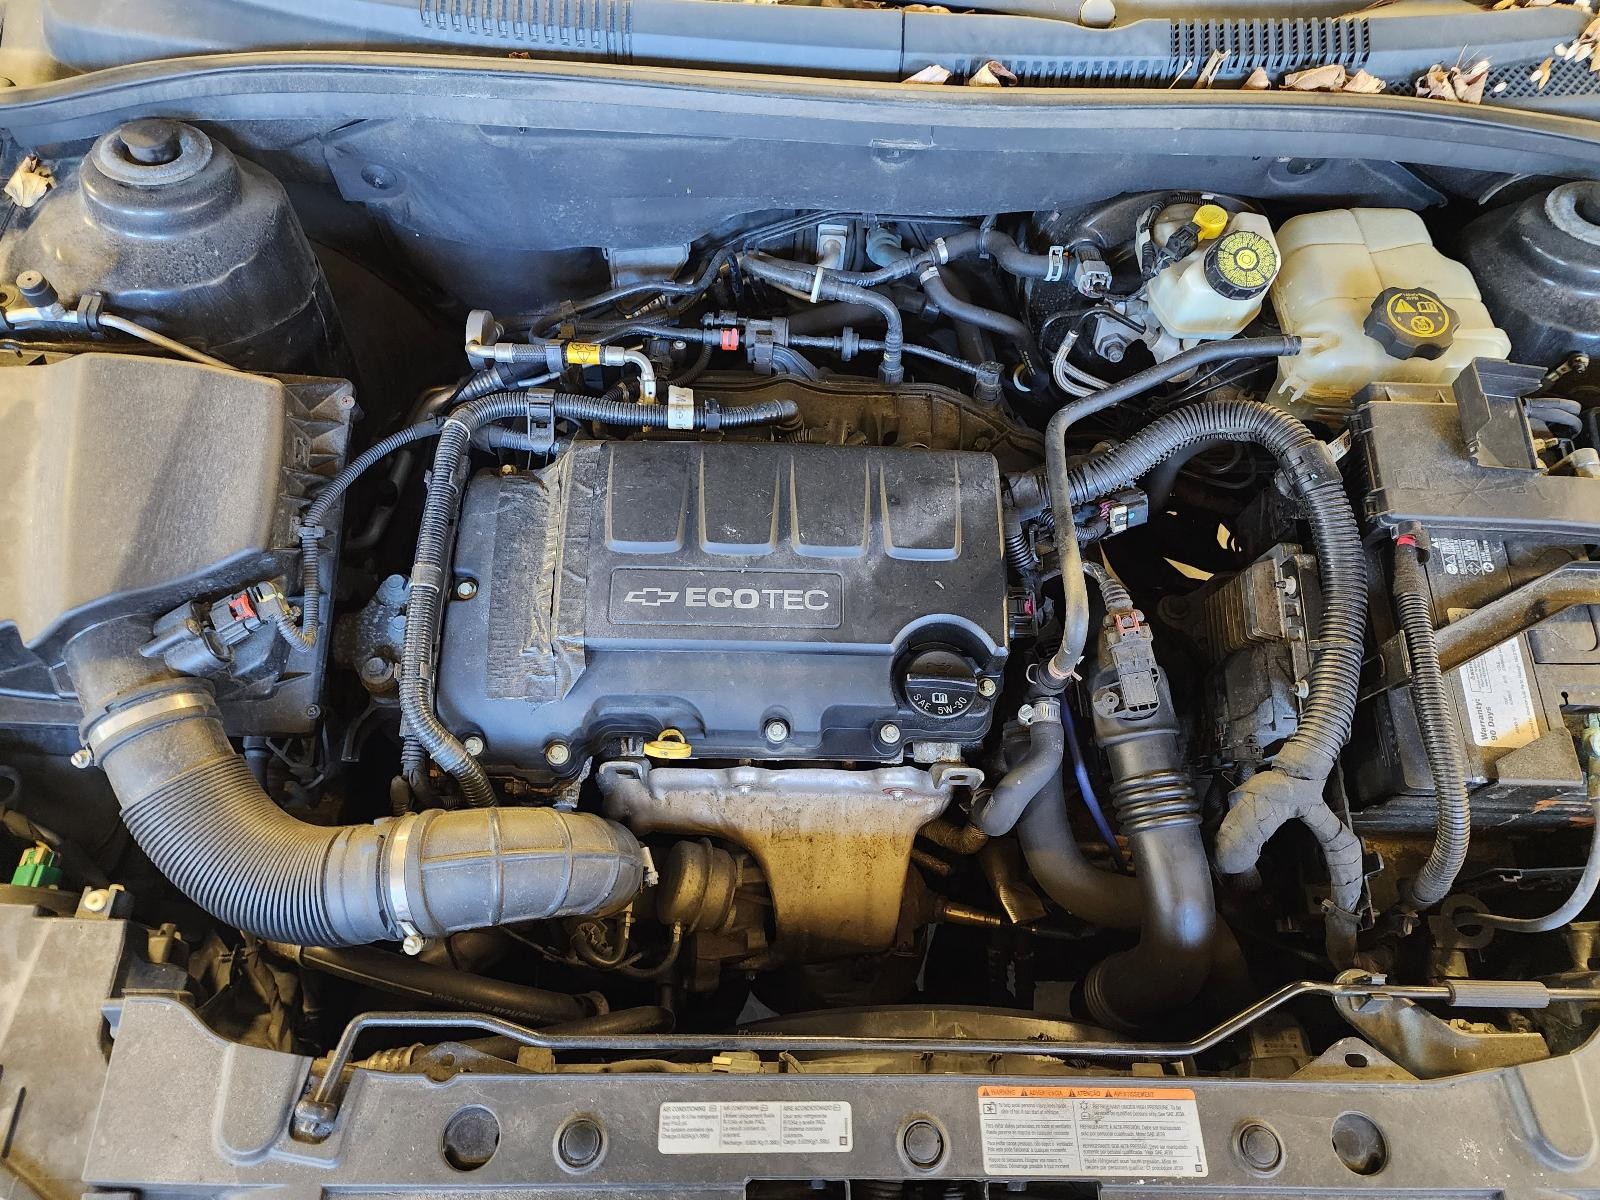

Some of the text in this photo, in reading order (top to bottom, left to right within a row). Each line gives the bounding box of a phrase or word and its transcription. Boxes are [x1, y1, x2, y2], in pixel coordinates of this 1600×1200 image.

[684, 587, 829, 610] ECOTEC
[913, 693, 968, 715] SAE 5W-30
[1475, 698, 1488, 740] Warranty:
[1485, 706, 1498, 741] 90 Days
